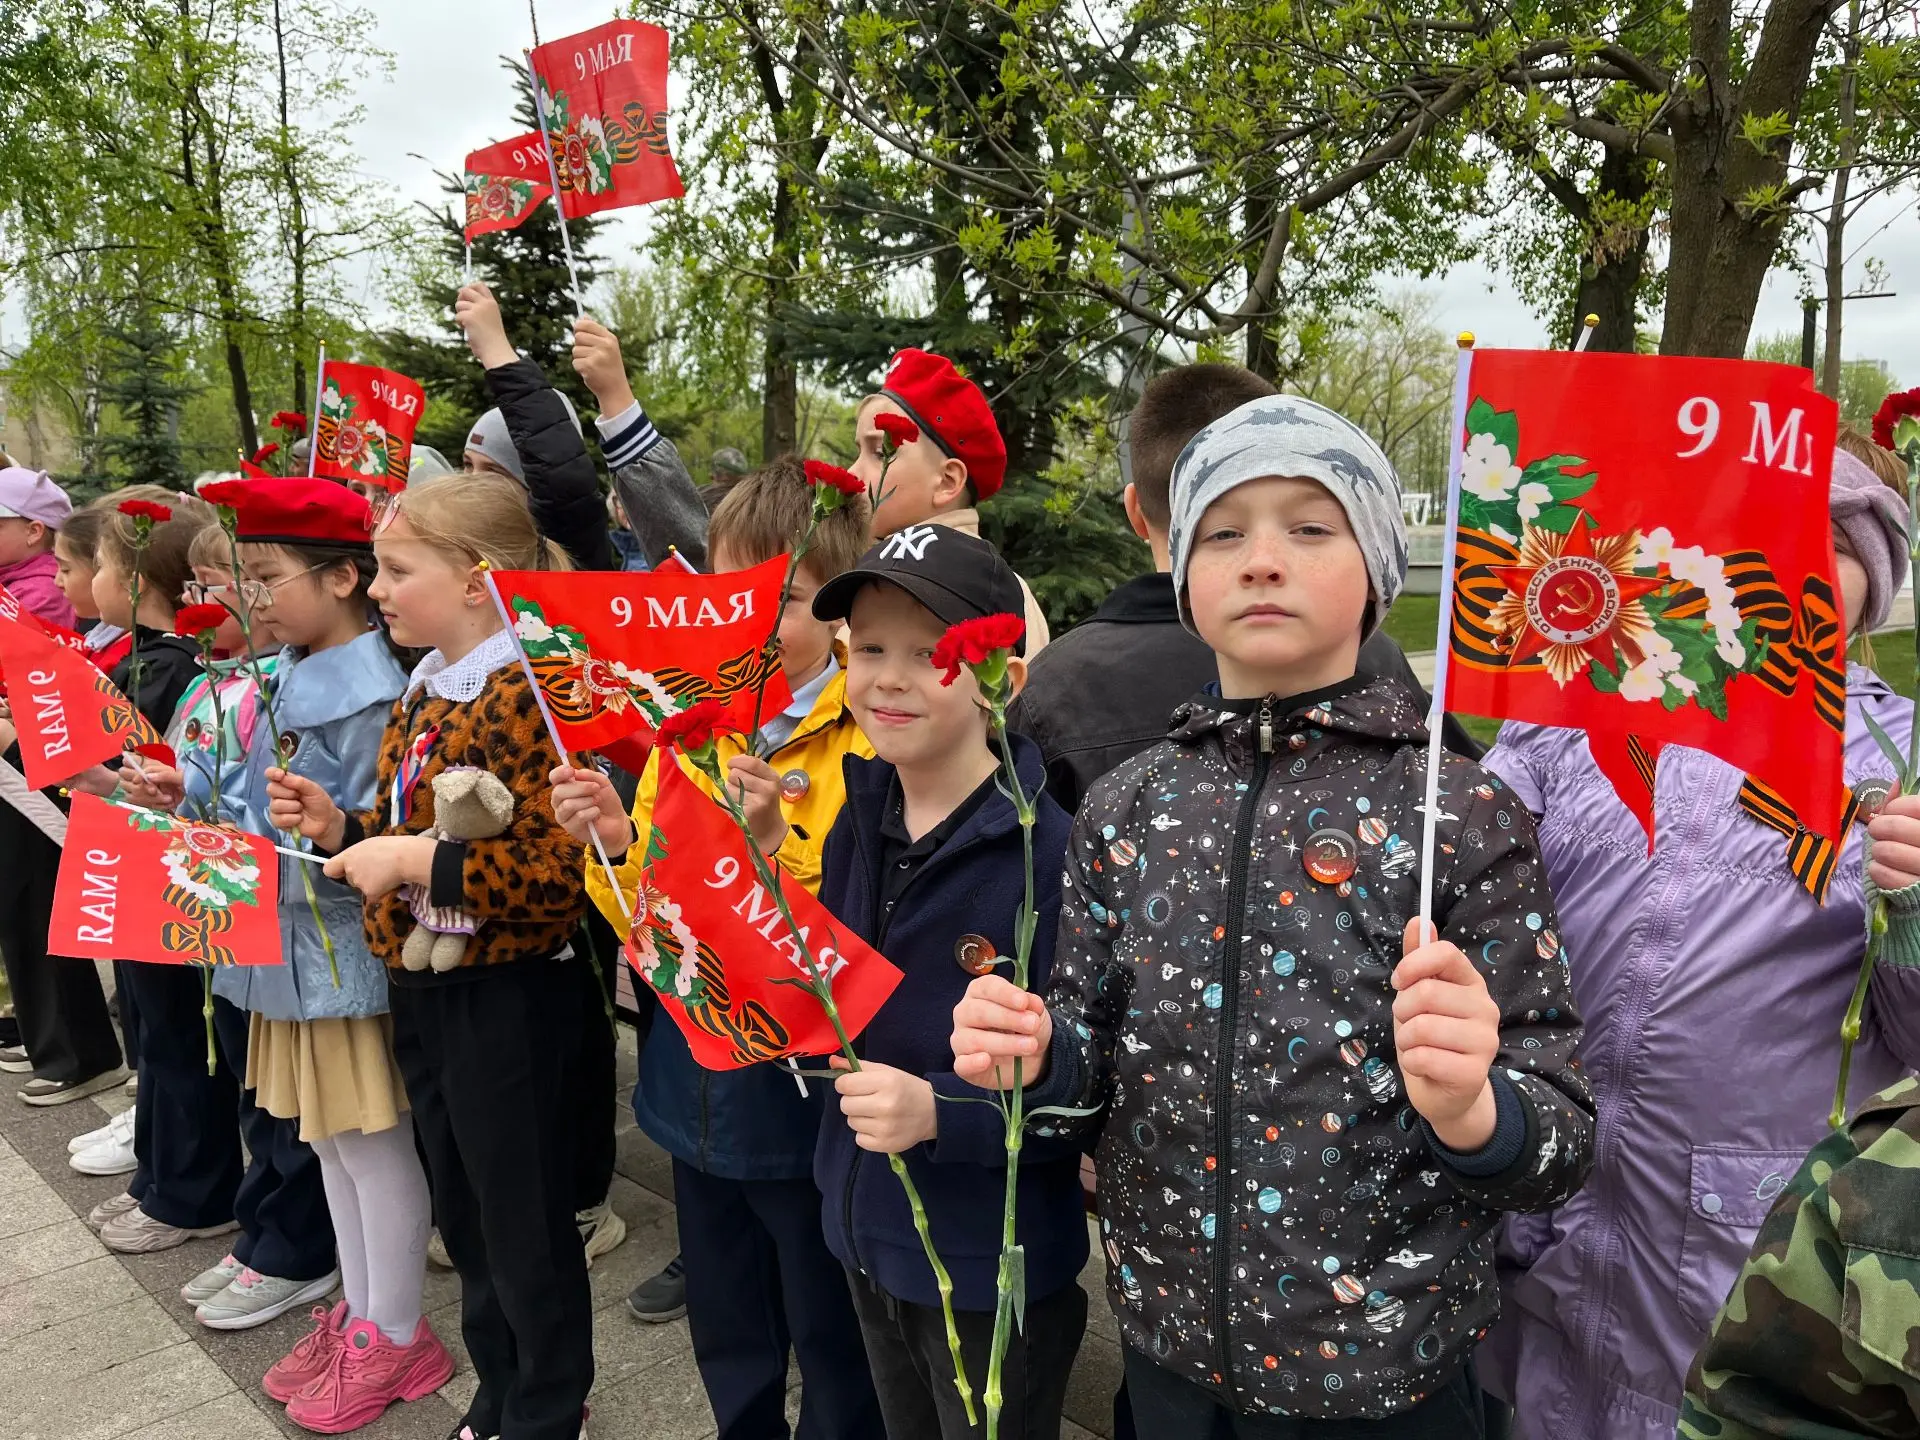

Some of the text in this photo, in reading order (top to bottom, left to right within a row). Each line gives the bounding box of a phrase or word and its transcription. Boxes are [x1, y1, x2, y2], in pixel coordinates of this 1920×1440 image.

[573, 33, 635, 81] 9 МАЯ
[512, 150, 527, 171] 9
[371, 379, 381, 399] 9
[1676, 396, 1720, 458] 9
[879, 526, 939, 561] NY
[610, 588, 756, 629] 9 МАЯ
[1528, 558, 1611, 634] ОТЕЧЕСТВЕННАЯ
[703, 856, 849, 983] 9 МАЯ
